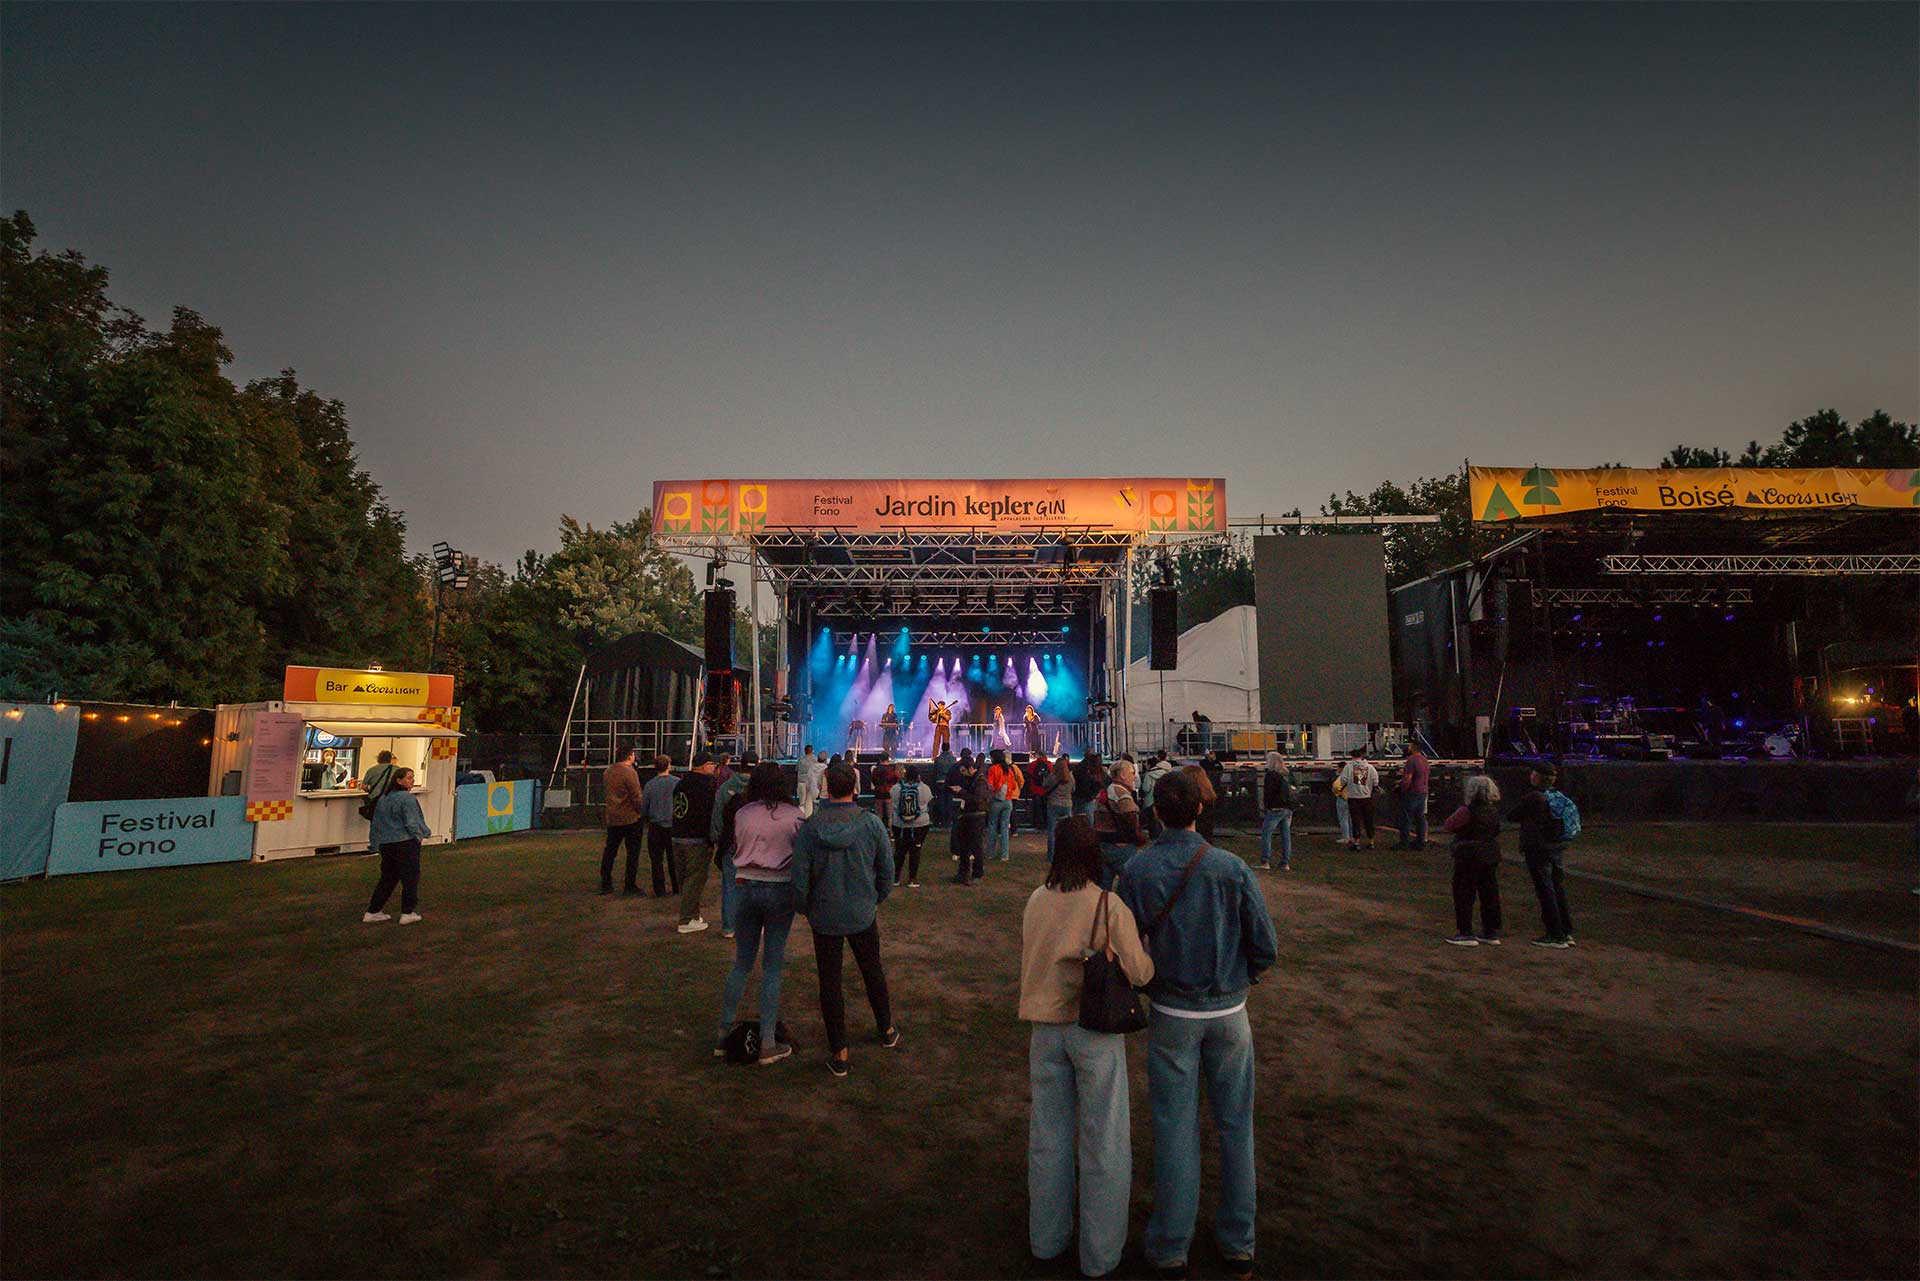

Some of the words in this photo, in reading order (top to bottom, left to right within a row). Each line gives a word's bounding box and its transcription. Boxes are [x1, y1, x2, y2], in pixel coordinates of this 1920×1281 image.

[1595, 486, 1638, 497] Festival
[1658, 484, 1734, 507] Boisé
[1761, 488, 1814, 505] Coors
[1815, 492, 1858, 504] LIGHT
[813, 495, 853, 505] Festival
[1597, 498, 1628, 507] Fono
[813, 506, 840, 516] Fono
[875, 495, 956, 516] Jardin
[965, 495, 1034, 521] kepler
[1036, 499, 1066, 517] GIN
[326, 680, 349, 691] Bar
[365, 683, 394, 694] Coors
[395, 687, 421, 695] LIGHT
[101, 809, 216, 834] Festival
[98, 838, 176, 858] Fono
